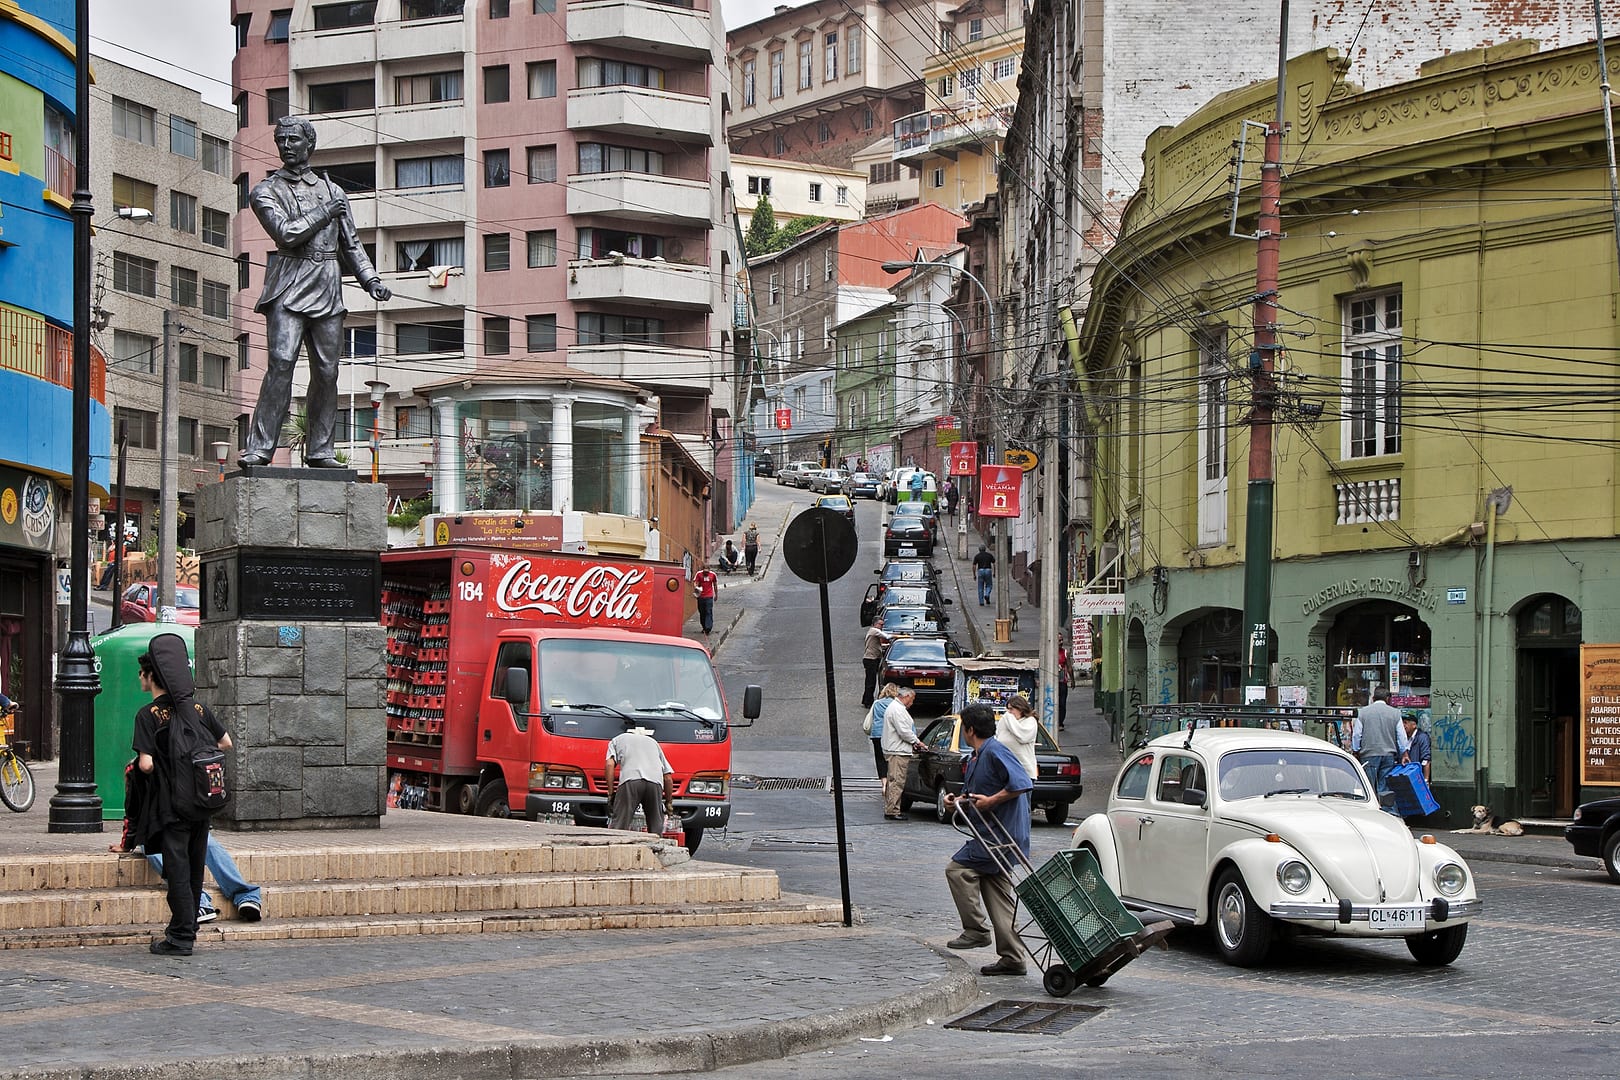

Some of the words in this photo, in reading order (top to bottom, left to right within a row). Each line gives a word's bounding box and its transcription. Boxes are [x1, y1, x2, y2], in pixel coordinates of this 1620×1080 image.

[499, 517, 508, 525] de
[244, 565, 278, 575] CARLOS
[280, 566, 321, 576] CONDELL
[323, 566, 335, 577] DE
[336, 567, 349, 577] LA
[273, 580, 304, 591] PUNTA
[308, 582, 346, 592] GRUESA
[457, 581, 484, 601] 184
[277, 597, 290, 607] DE
[292, 598, 317, 608] MAYO
[319, 598, 334, 608] DE
[1302, 578, 1358, 616] CONSERVAS
[1603, 747, 1612, 755] DE
[1590, 757, 1605, 766] PAN
[551, 801, 571, 813] 184
[704, 806, 722, 817] 184
